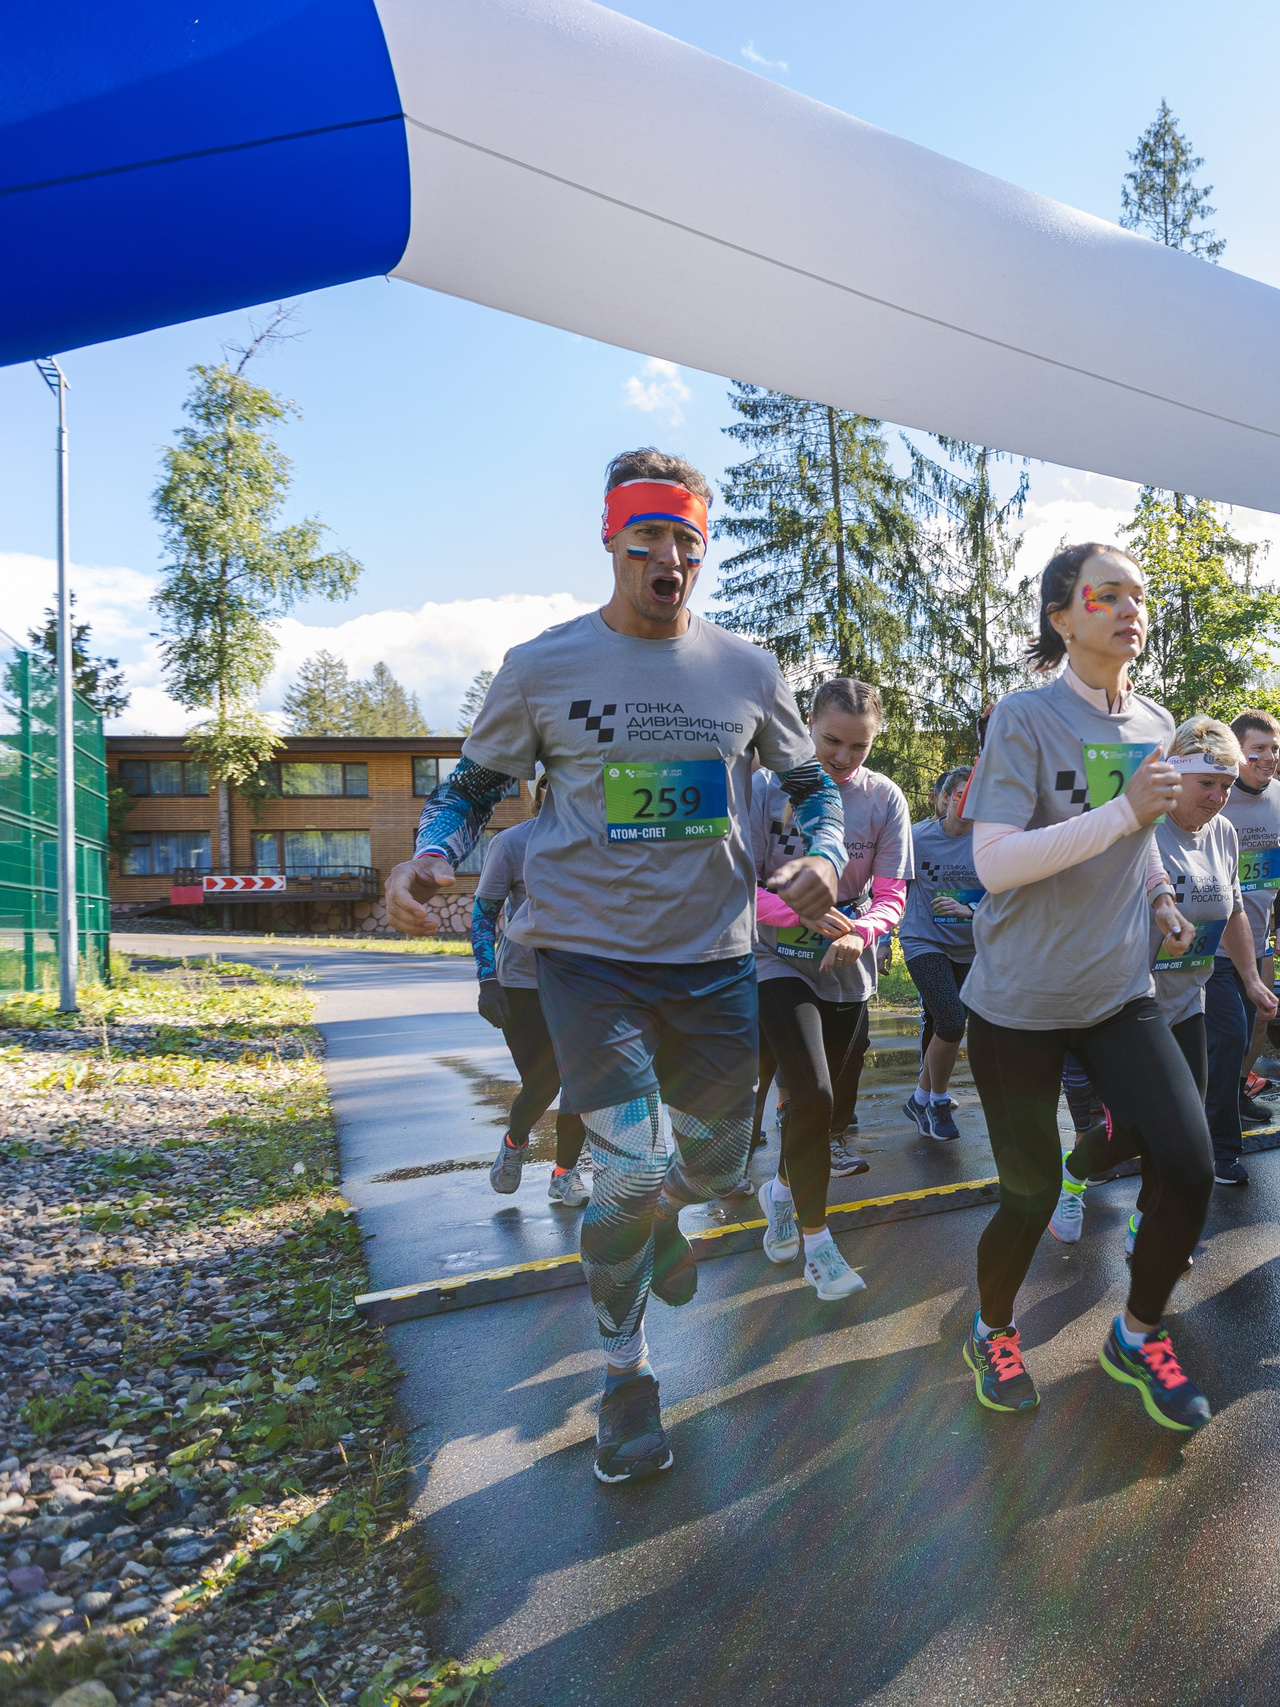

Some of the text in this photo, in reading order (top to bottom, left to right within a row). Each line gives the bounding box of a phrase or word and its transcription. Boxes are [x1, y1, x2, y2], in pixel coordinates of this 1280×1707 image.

[625, 702, 684, 714] ГОНКА
[627, 716, 743, 734] ДИВИЗИОНОВ
[628, 729, 720, 743] РОСАТОМА
[632, 786, 701, 819] 259
[685, 825, 713, 835] ЯОК-1
[1243, 861, 1270, 880] 255
[1190, 875, 1218, 883] ГОНКА
